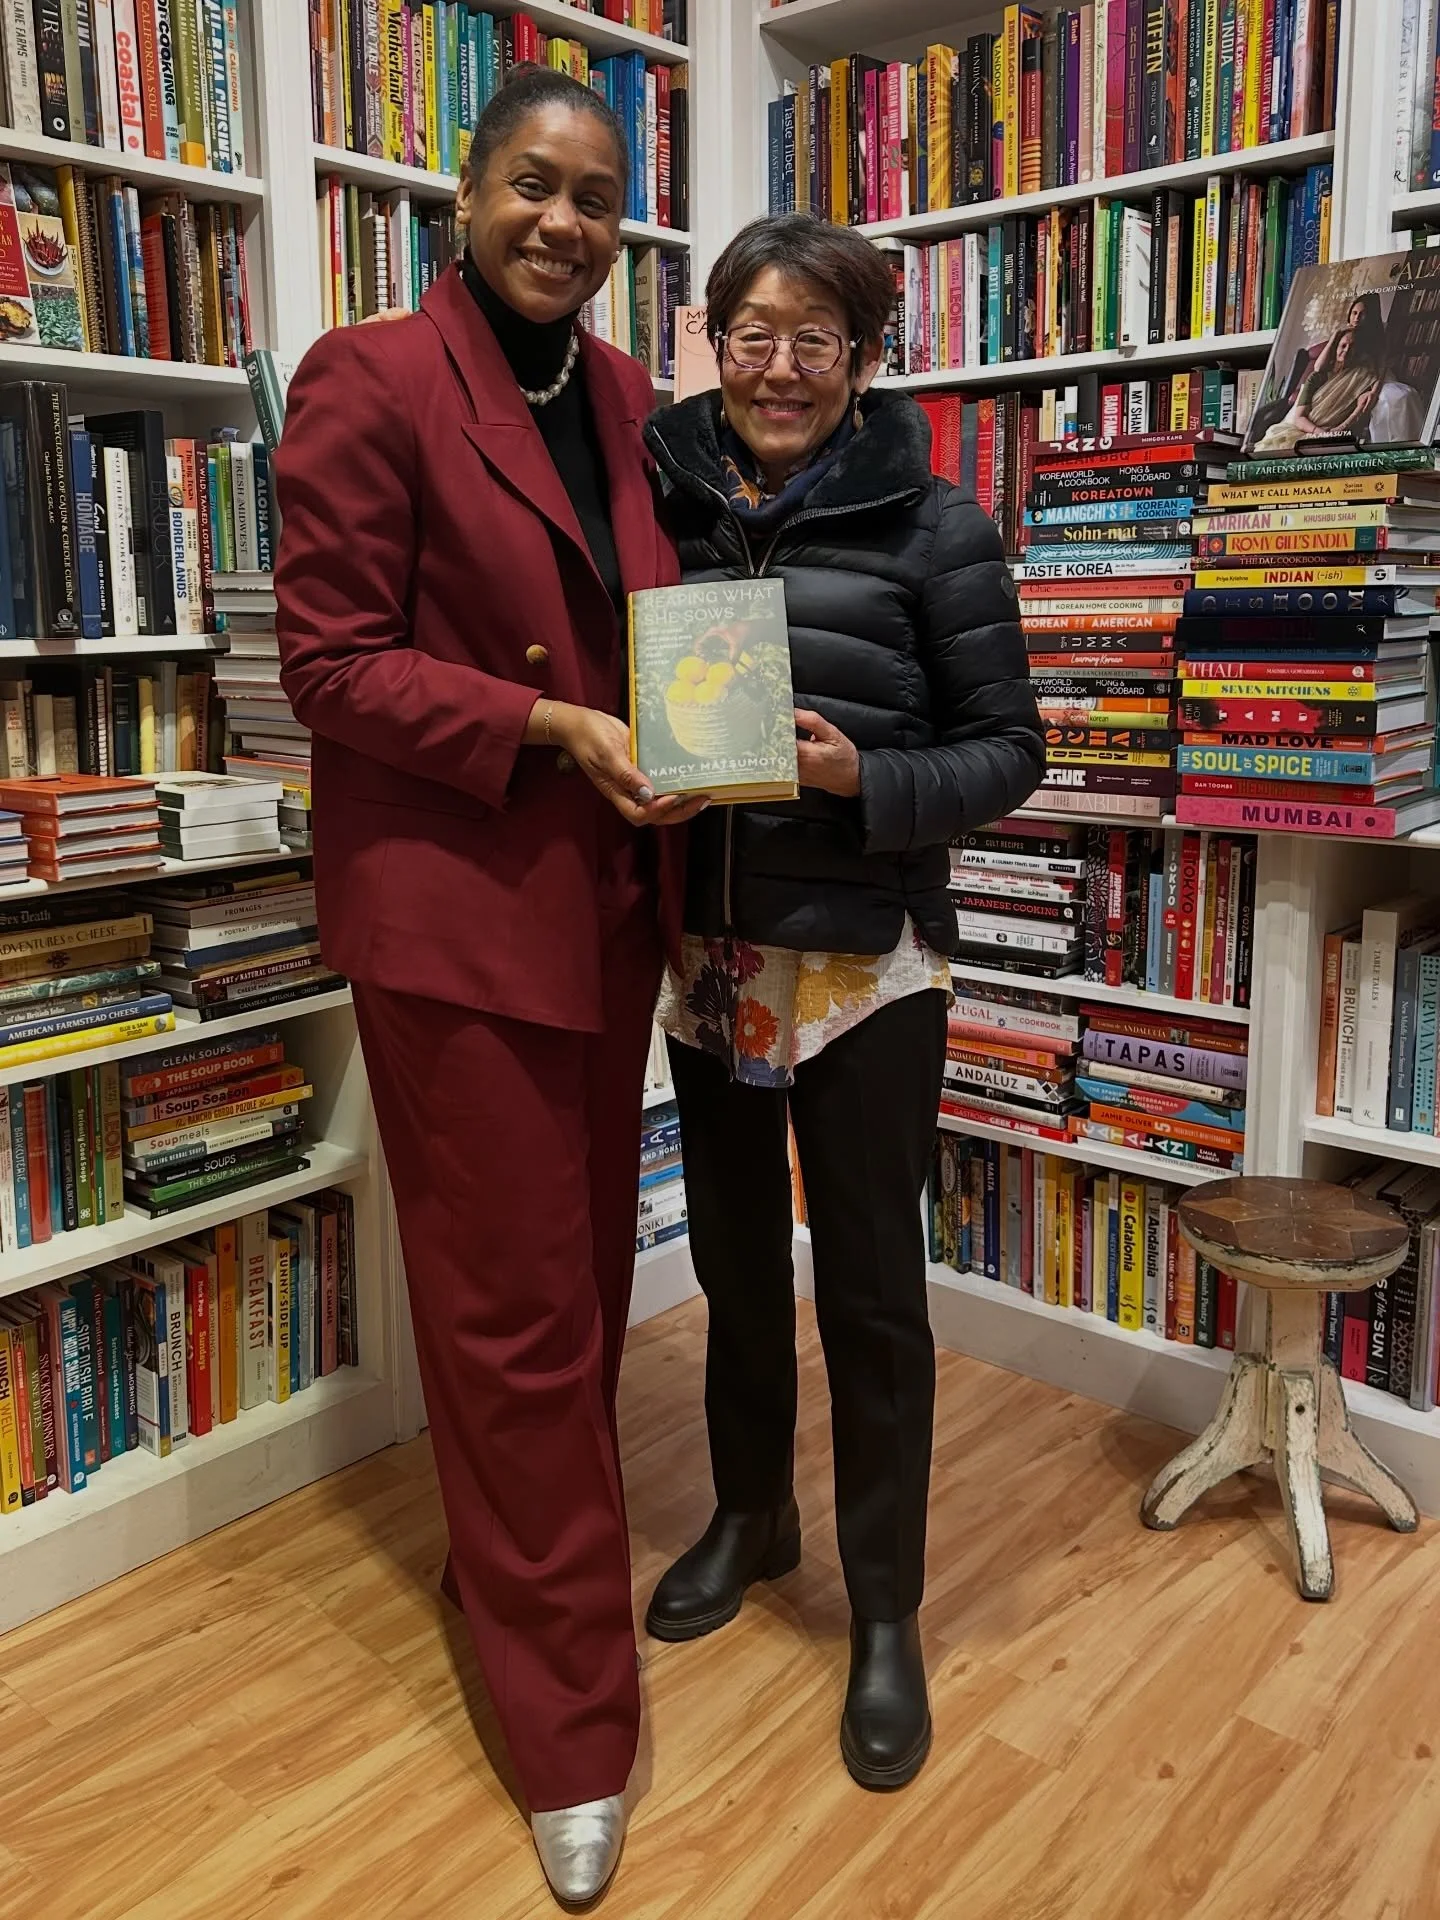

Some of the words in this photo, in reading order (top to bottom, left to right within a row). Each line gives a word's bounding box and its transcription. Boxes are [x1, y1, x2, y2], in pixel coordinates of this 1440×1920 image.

[142, 1, 155, 83] CALIFORNIA
[1071, 19, 1079, 45] Sindh
[1147, 7, 1163, 73] TIFFIN
[1221, 21, 1234, 67] INDIA
[388, 8, 403, 110] Motherland
[413, 33, 422, 81] TACOS
[117, 32, 141, 127] coastal
[1234, 46, 1243, 93] EXPRESS
[460, 44, 469, 125] DIASPORICAN
[889, 71, 898, 103] MODERN
[1128, 26, 1137, 143] KOLKATA
[148, 86, 156, 120] SOUL
[1204, 90, 1213, 136] MEMSAHIB
[785, 104, 794, 139] Taste
[889, 108, 898, 139] INDIAN
[785, 140, 794, 174] Tibet
[950, 286, 961, 328] LEON
[1050, 436, 1113, 452] JANG
[235, 457, 245, 497] FRESH
[1040, 470, 1095, 481] KOREAWORLD:
[1119, 467, 1143, 475] HONG
[1131, 472, 1170, 482] RODBARD
[1255, 463, 1296, 475] ZAREEN'S
[1297, 460, 1343, 472] PAKISTANI
[1345, 458, 1384, 469] KITCHEN
[115, 451, 126, 519] SOUTHERN
[1065, 477, 1110, 487] COOKBOOK
[1072, 487, 1153, 501] KOREATOWN
[1221, 491, 1248, 500] WHAT
[1251, 489, 1265, 498] WE
[1267, 488, 1290, 497] CALL
[1293, 485, 1332, 495] MASALA
[1046, 503, 1117, 523] MAANGCHI'S
[1136, 501, 1178, 510] KOREAN
[1136, 509, 1178, 518] COOKING
[76, 492, 96, 553] HOMAGE
[236, 500, 248, 554] MIDWEST
[1207, 514, 1271, 531] AMRIKAN
[1303, 514, 1335, 524] KHUSHBU
[1337, 512, 1357, 521] SHAH
[1063, 526, 1137, 542] Sohn-mat
[1231, 536, 1273, 551] ROMY
[1275, 534, 1309, 550] GILL'S
[1312, 532, 1349, 548] INDIA
[172, 511, 186, 599] BORDERLANDS
[1239, 557, 1258, 565] THE
[1259, 556, 1275, 564] DAL
[1276, 555, 1328, 564] COOKBOOK
[1023, 565, 1062, 578] TASTE
[1066, 563, 1113, 576] KOREA
[1263, 570, 1314, 584] INDIAN
[1317, 571, 1343, 581] (-ish)
[645, 589, 718, 609] REAPING
[723, 586, 774, 603] WHAT
[1056, 602, 1085, 610] KOREAN
[1202, 589, 1365, 612] DISHOOM
[644, 611, 679, 625] SHE
[684, 606, 735, 623] SOWS
[1024, 618, 1069, 629] KOREAN
[1091, 617, 1153, 628] AMERICAN
[1071, 654, 1100, 666] Learning
[1099, 654, 1124, 664] Korean
[1188, 662, 1244, 678] THALI
[1221, 683, 1262, 694] SEVEN
[1266, 685, 1331, 696] KITCHENS
[1221, 734, 1270, 746] MAD
[1275, 736, 1334, 748] LOVE
[650, 765, 695, 778] NANCY
[700, 757, 788, 772] MATSUMOTO
[1181, 752, 1189, 767] THE
[1191, 752, 1242, 772] SOUL
[1244, 757, 1251, 768] OF
[1254, 755, 1312, 776] SPICE
[1242, 806, 1353, 828] MUMBAI
[1001, 841, 1024, 849] RECIPES
[963, 855, 986, 864] JAPAN
[1113, 872, 1122, 919] JAPANESE
[1182, 859, 1196, 915] TOKYO
[225, 904, 262, 916] FROMAGES
[963, 897, 1012, 910] JAPANESE
[1013, 904, 1059, 916] COOKING
[1242, 906, 1250, 937] GYOZA
[222, 975, 234, 985] ART
[240, 968, 266, 981] NATURAL
[268, 958, 311, 974] CHEESEMAKING
[237, 986, 258, 994] CHEESE
[258, 980, 282, 990] MAKING
[1372, 977, 1380, 1002] TALES
[8, 1023, 54, 1040] AMERICAN
[56, 1012, 107, 1032] FARMSTEAD
[109, 1007, 140, 1020] CHEESE
[1020, 1018, 1061, 1030] COOKBOOK
[1419, 977, 1438, 1068] PARWANA
[162, 1052, 196, 1068] CLEAN
[199, 1045, 232, 1059] SOUPS
[1105, 1039, 1185, 1072] TAPAS
[167, 1072, 189, 1084] THE
[191, 1064, 221, 1079] SOUP
[224, 1055, 254, 1071] BOOK
[956, 1067, 1018, 1089] ANDALUZ
[166, 1096, 199, 1115] Soup
[203, 1087, 249, 1105] Season
[188, 1111, 212, 1124] RANCHO
[214, 1106, 234, 1119] GORDO
[236, 1102, 257, 1114] POZOLE
[77, 1108, 85, 1142] Seriously
[104, 1111, 121, 1161] LEON
[150, 1127, 210, 1150] Soupmeals
[204, 1155, 236, 1172] SOUPS
[1197, 1154, 1220, 1162] WARREN
[1199, 1149, 1217, 1157] EMMA
[188, 1178, 203, 1189] THE
[206, 1171, 228, 1184] SOUP
[230, 1156, 269, 1175] SOLUTION
[987, 1161, 995, 1191] MALTA
[1124, 1215, 1136, 1272] Catalonia
[1147, 1216, 1160, 1278] Andalusia
[1202, 1262, 1210, 1292] Spanish
[249, 1255, 265, 1350] BREAKFAST
[279, 1252, 289, 1329] SUNNY-SIDE
[1376, 1291, 1388, 1302] of
[1199, 1294, 1208, 1326] Pantry
[1376, 1303, 1385, 1318] the
[170, 1311, 182, 1372] BRUNCH
[280, 1335, 289, 1348] UP
[1372, 1320, 1385, 1358] SUN
[40, 1353, 51, 1414] SNACKING
[42, 1414, 55, 1460] DINNERS
